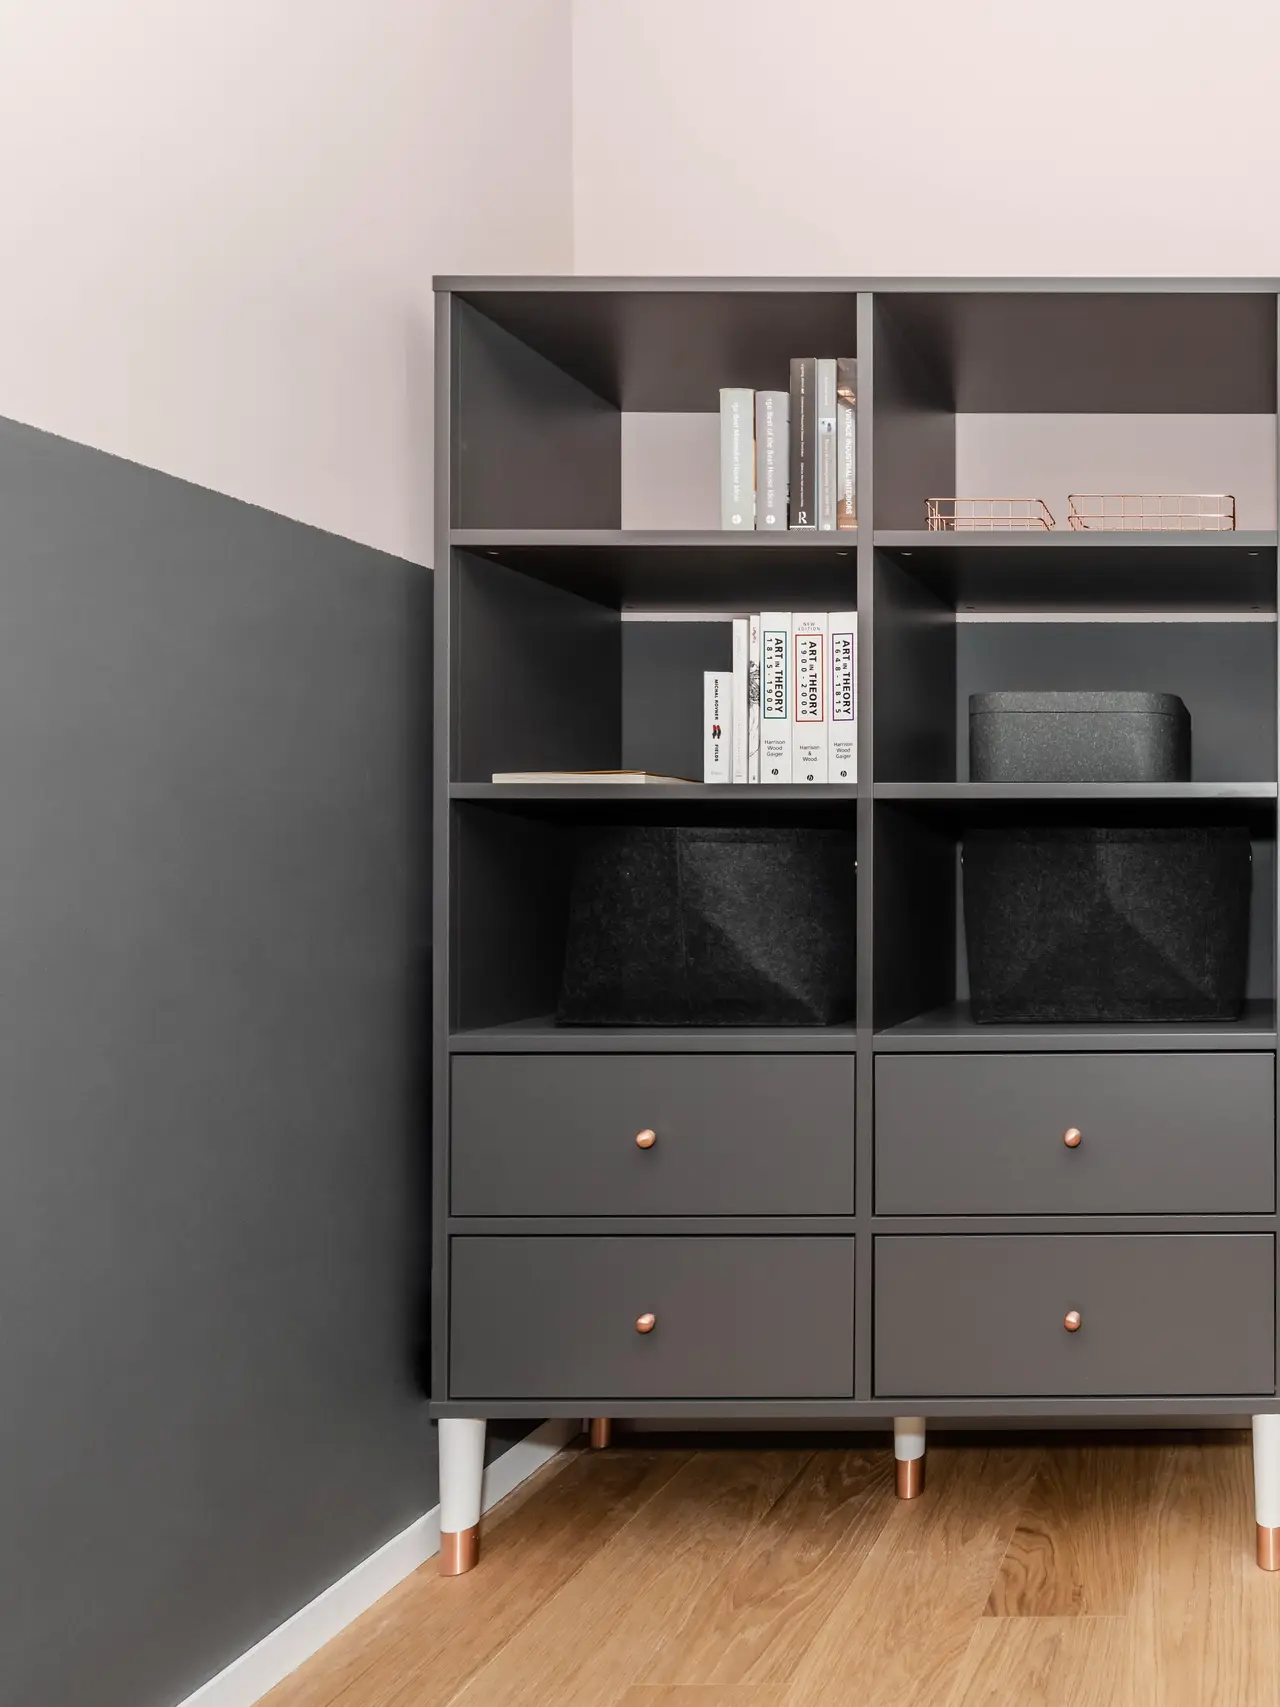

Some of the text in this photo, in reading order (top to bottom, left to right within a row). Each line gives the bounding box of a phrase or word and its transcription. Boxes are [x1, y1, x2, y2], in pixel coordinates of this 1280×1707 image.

[775, 638, 783, 659] ART
[809, 641, 817, 662] ART
[842, 640, 850, 660] ART
[775, 670, 783, 713] THEORY
[808, 673, 817, 716] THEORY
[842, 672, 851, 714] THEORY
